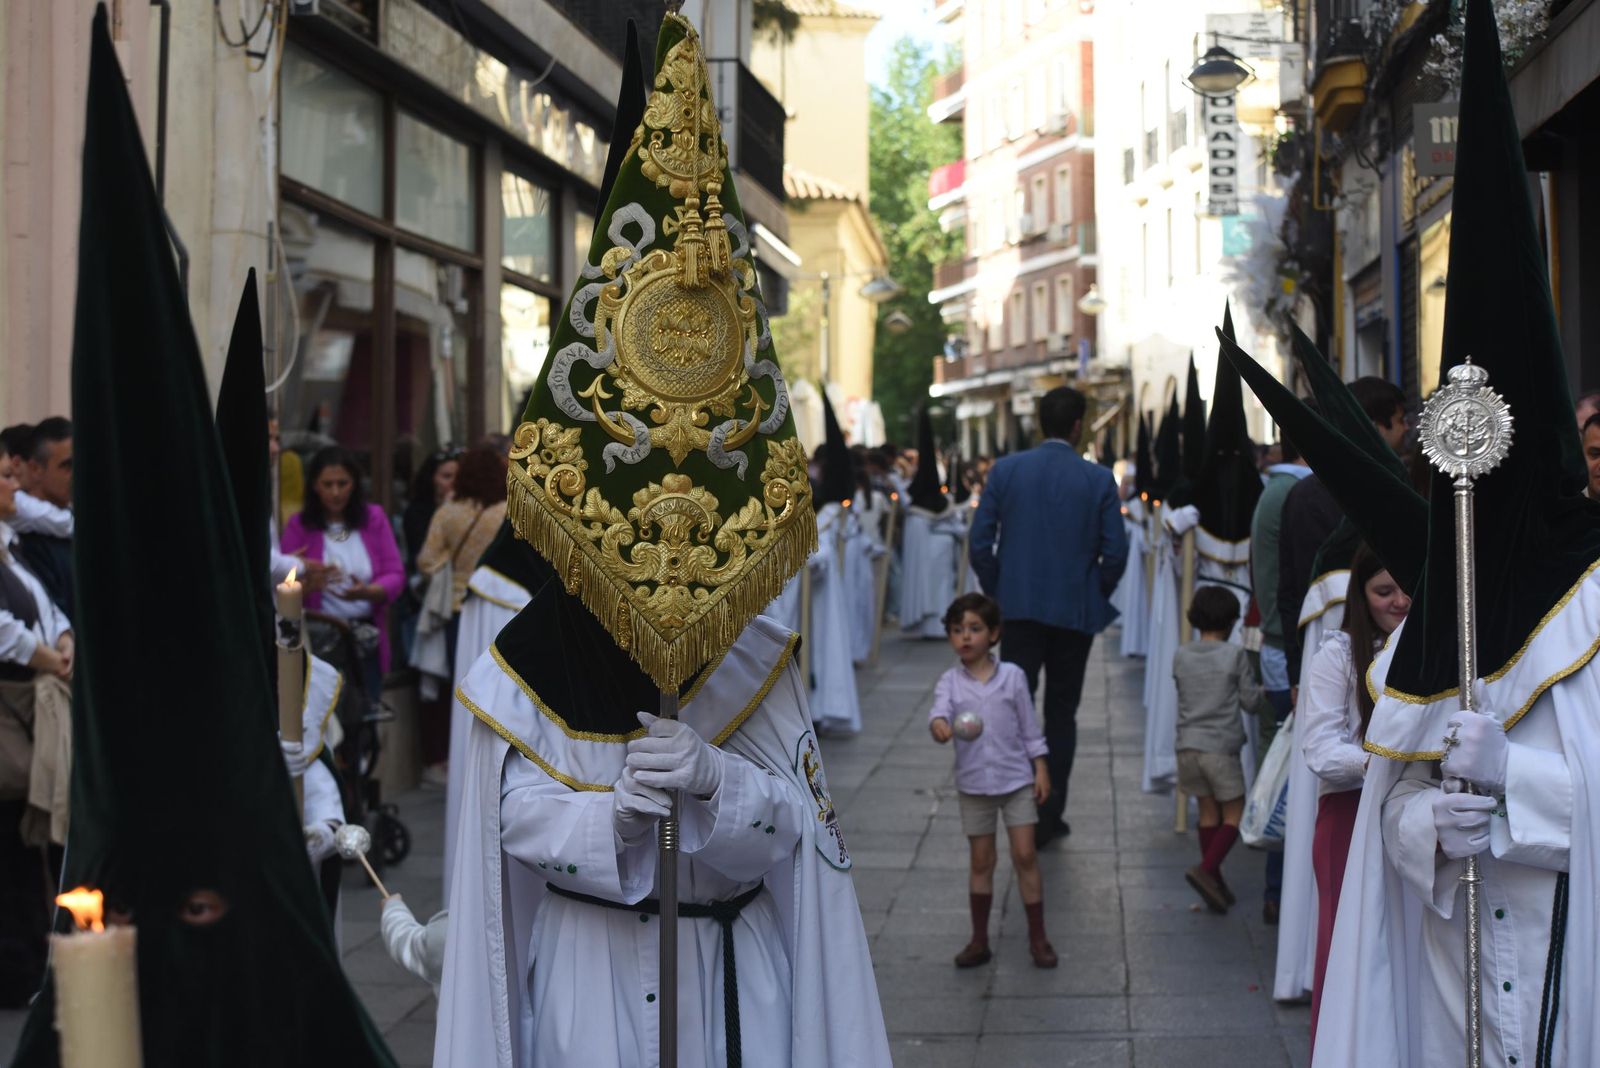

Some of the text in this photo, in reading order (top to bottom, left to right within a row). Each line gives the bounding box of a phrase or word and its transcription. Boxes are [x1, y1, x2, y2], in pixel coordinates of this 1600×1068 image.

[1210, 95, 1235, 195] OGADOS
[575, 289, 594, 305] LA
[572, 310, 589, 334] SOIS
[561, 397, 584, 419] LOS
